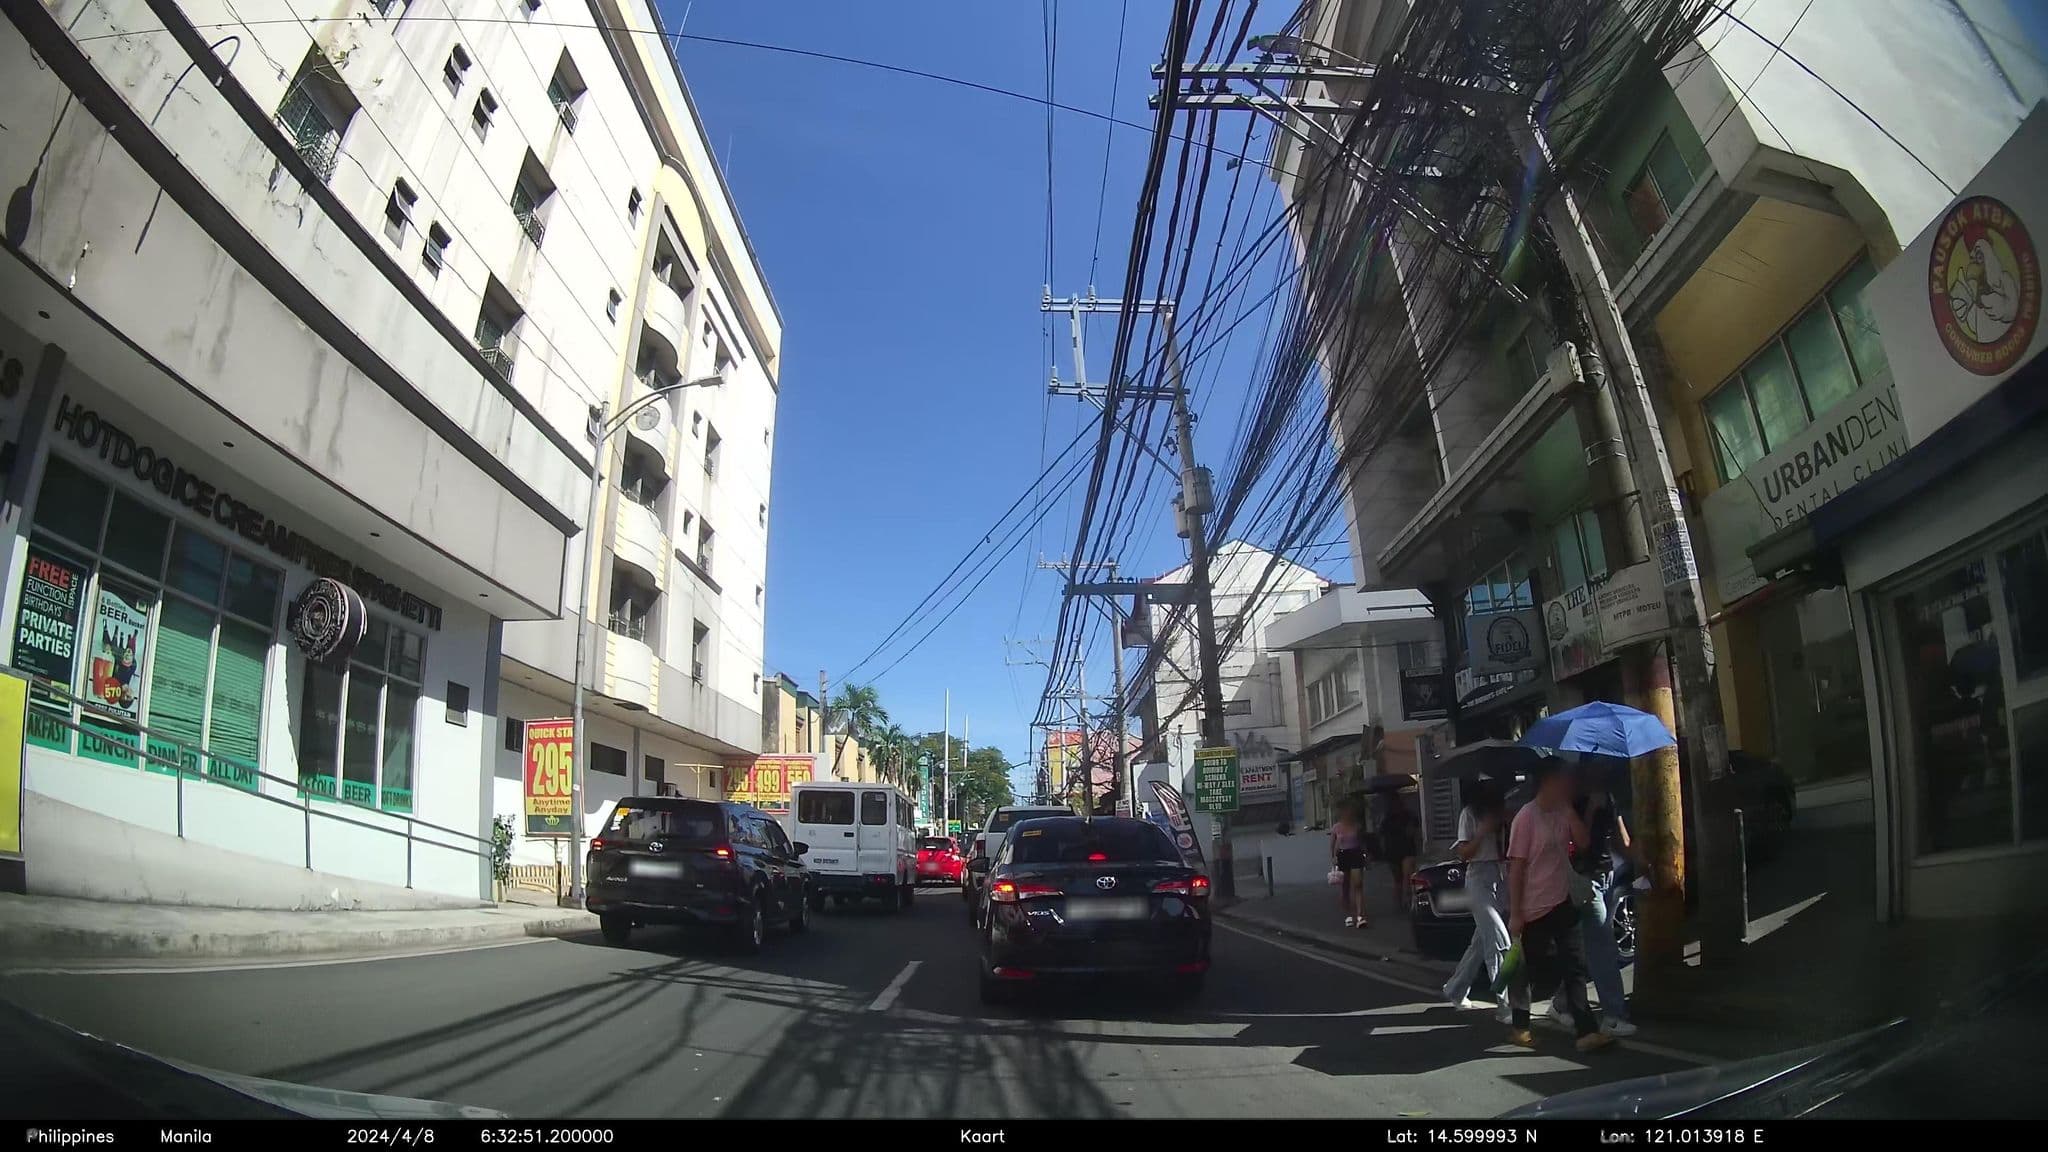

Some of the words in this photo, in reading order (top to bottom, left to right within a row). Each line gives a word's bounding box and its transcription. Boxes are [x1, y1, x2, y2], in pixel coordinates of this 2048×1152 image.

[1933, 211, 1969, 295] PAUSOK
[28, 556, 71, 588] FREE
[26, 578, 68, 602] FUNCTION
[67, 573, 79, 607] SPACE
[24, 594, 63, 618] BIRTHDAYS
[99, 604, 128, 624] BEER
[21, 608, 74, 640] PRIVATE
[19, 627, 72, 659] PARTIES
[104, 686, 122, 699] 570
[528, 727, 556, 740] QUICK
[82, 728, 135, 761] LUNCH
[148, 744, 199, 772] DINNER
[532, 742, 573, 796] 295
[1242, 772, 1272, 784] RENT
[344, 784, 372, 803] BEER
[533, 798, 571, 807] Anytime
[534, 805, 569, 814] Anyday
